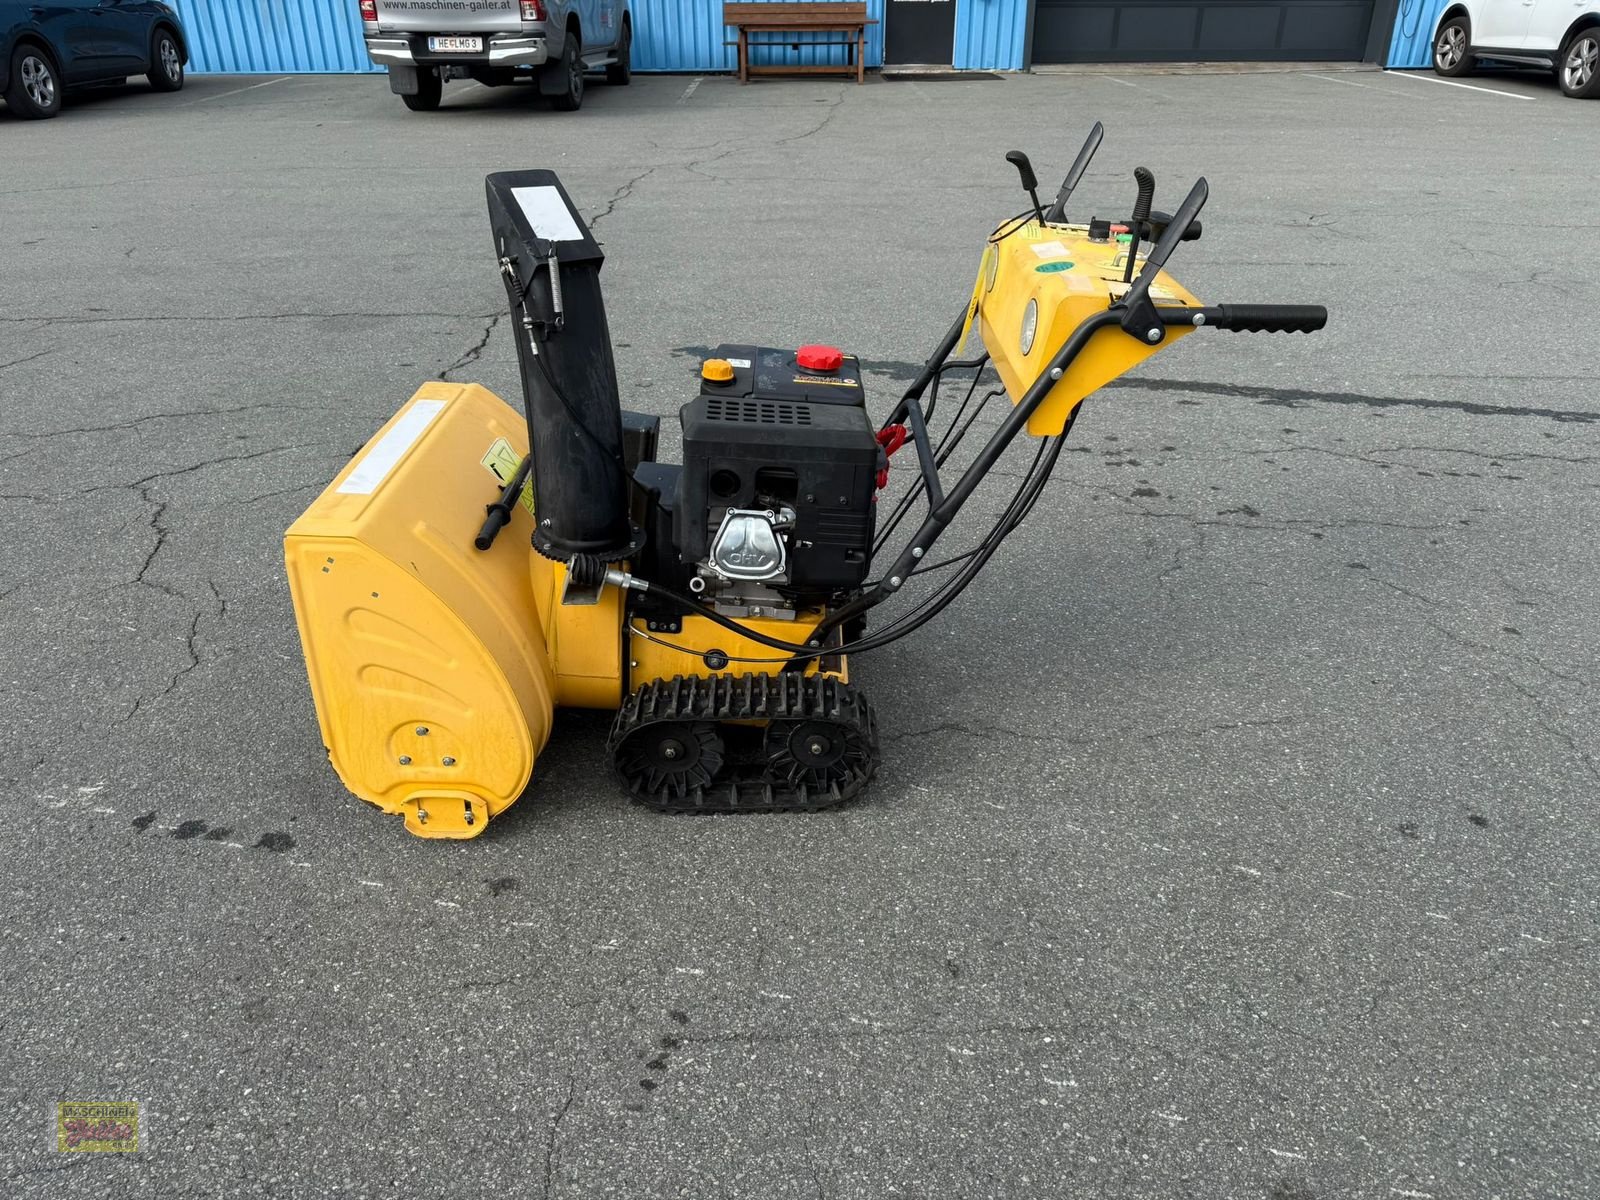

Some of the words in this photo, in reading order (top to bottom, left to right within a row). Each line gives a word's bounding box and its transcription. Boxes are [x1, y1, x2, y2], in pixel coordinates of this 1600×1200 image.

[384, 0, 511, 12] www.maschinen-gailer.at
[438, 39, 449, 49] HE
[454, 39, 471, 49] LMG
